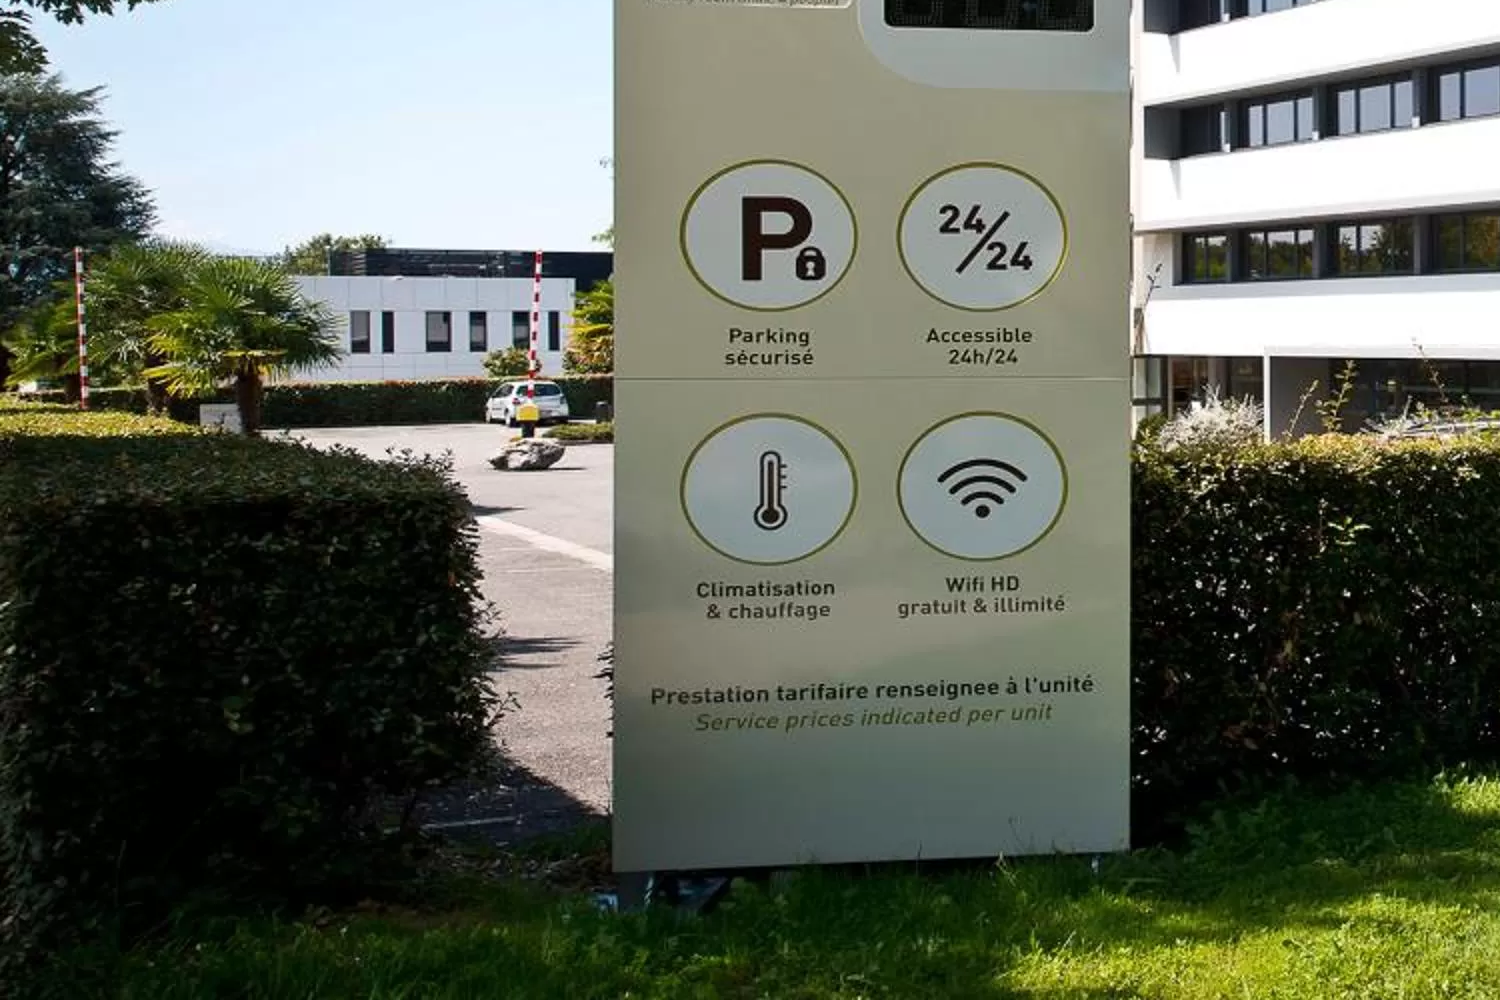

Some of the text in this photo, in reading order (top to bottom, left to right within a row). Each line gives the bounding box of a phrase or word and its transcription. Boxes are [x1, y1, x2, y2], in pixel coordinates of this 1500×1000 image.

[741, 195, 813, 281] P
[729, 327, 811, 346] Parking
[926, 327, 1033, 344] Accessible
[725, 350, 815, 366] sécurisé
[949, 349, 1019, 365] 24h/24
[696, 581, 836, 598] Climatisation
[946, 576, 1020, 593] Wifi HD
[706, 603, 831, 622] & chauffage
[898, 594, 1066, 619] gratuit & illimité
[651, 685, 770, 706] Prestation
[775, 682, 869, 702] tarifaire
[876, 679, 1000, 700] renseignee
[1006, 676, 1018, 695] à
[695, 703, 1053, 734] Service prices indicated per unit
